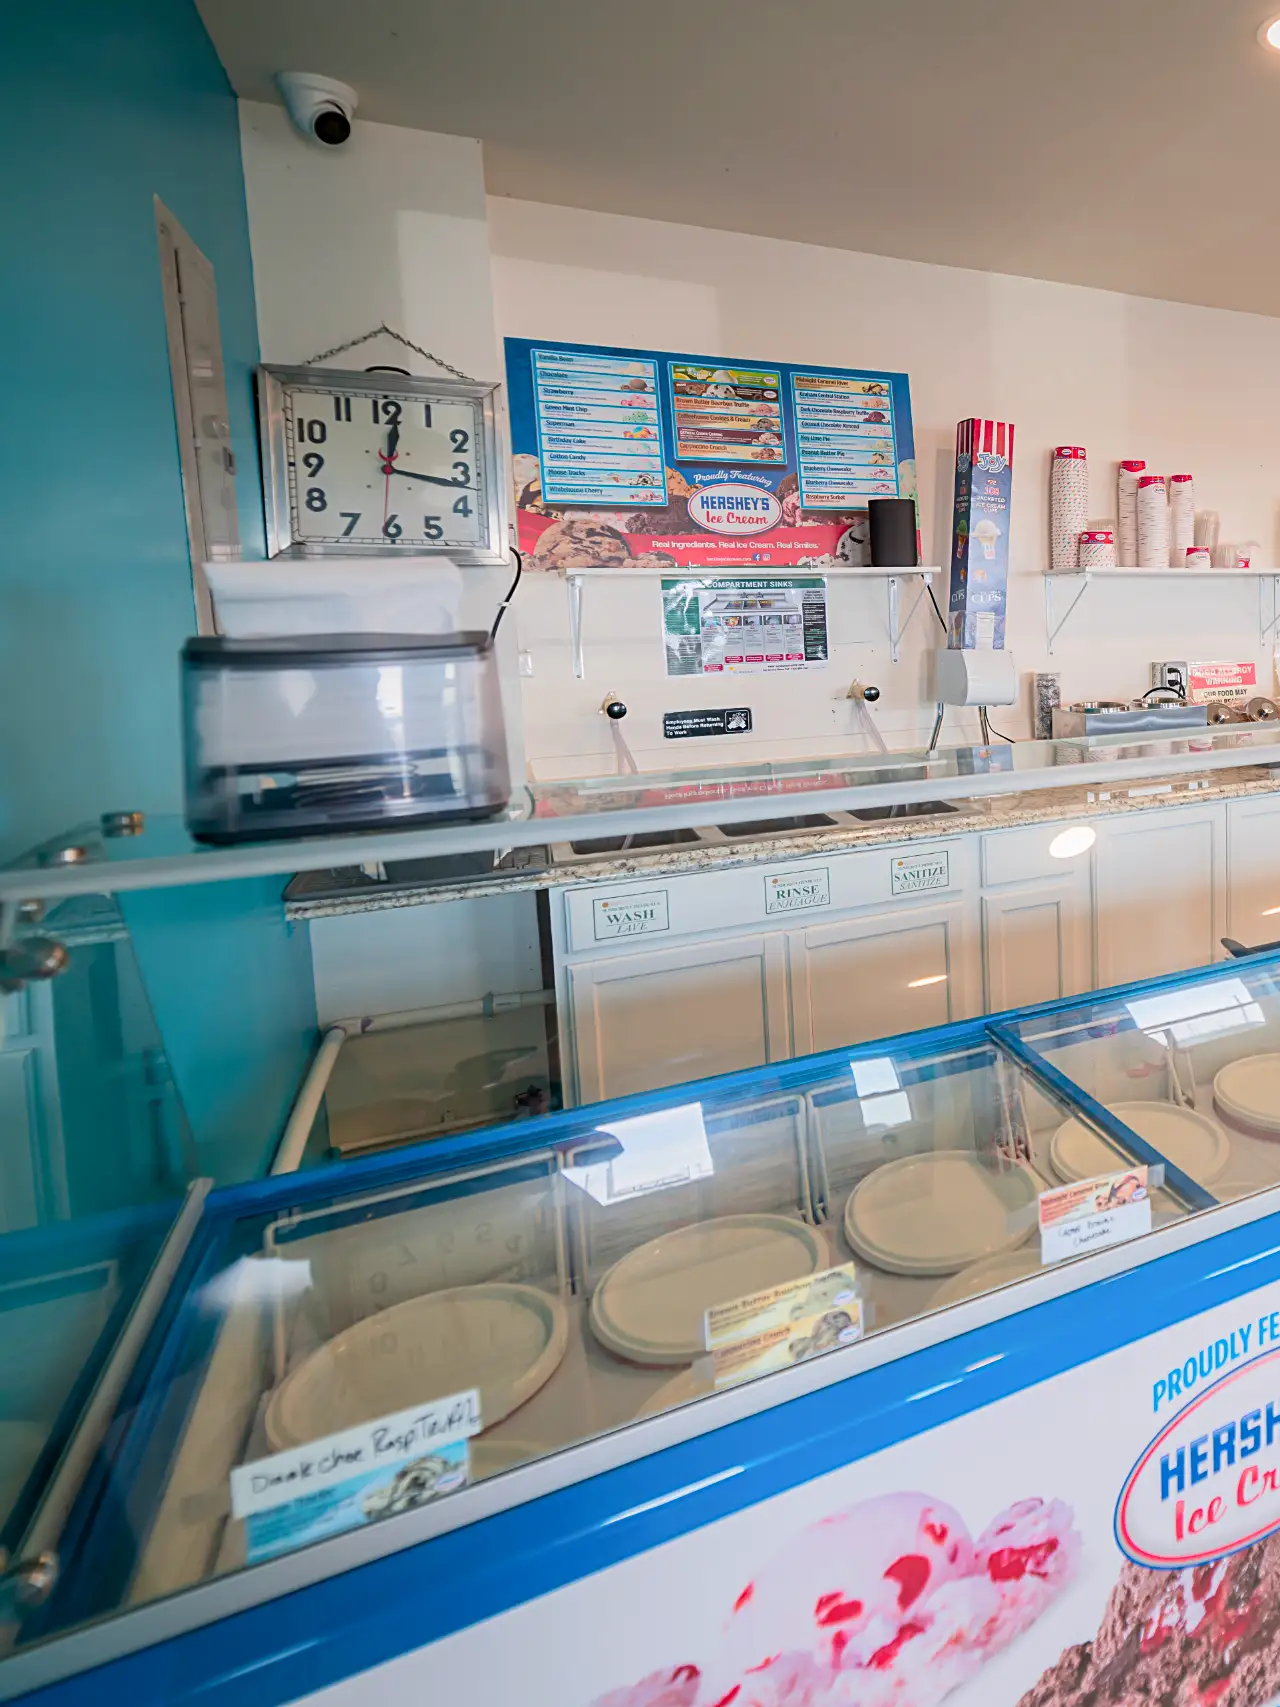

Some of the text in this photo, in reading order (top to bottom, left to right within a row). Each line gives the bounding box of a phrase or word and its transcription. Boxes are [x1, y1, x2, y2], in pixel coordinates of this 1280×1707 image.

[543, 387, 574, 396] Strawberry
[334, 396, 352, 422] 11
[372, 400, 402, 425] 12
[424, 404, 432, 428] 1
[297, 417, 327, 444] 10
[546, 420, 575, 428] Superman
[449, 429, 469, 453] 2
[302, 452, 324, 478] 9
[450, 461, 471, 487] 3
[693, 470, 773, 487] Proudly Featuring
[305, 487, 328, 512] 8
[452, 495, 473, 518] 4
[700, 495, 770, 511] HERSHEY'S
[339, 512, 362, 536] 7
[383, 514, 403, 538] 6
[424, 515, 444, 540] 5
[706, 511, 768, 525] Ice Cream
[652, 540, 670, 548] Real
[671, 541, 717, 551] Ingredients.
[718, 541, 736, 549] Real
[736, 541, 748, 549] Ice
[749, 541, 775, 549] Cream.
[769, 580, 793, 588] SINKS
[1205, 675, 1243, 686] WARNING
[1217, 689, 1234, 697] FOOD
[1234, 688, 1247, 696] MAY
[894, 866, 946, 882] SANITIZE
[769, 894, 828, 910] ENJUAGUE
[776, 885, 820, 900] RINSE
[606, 909, 656, 924] WASH
[617, 922, 648, 934] LAVE
[1152, 1323, 1253, 1415] PROUDLY
[1174, 1495, 1227, 1542] Ice
